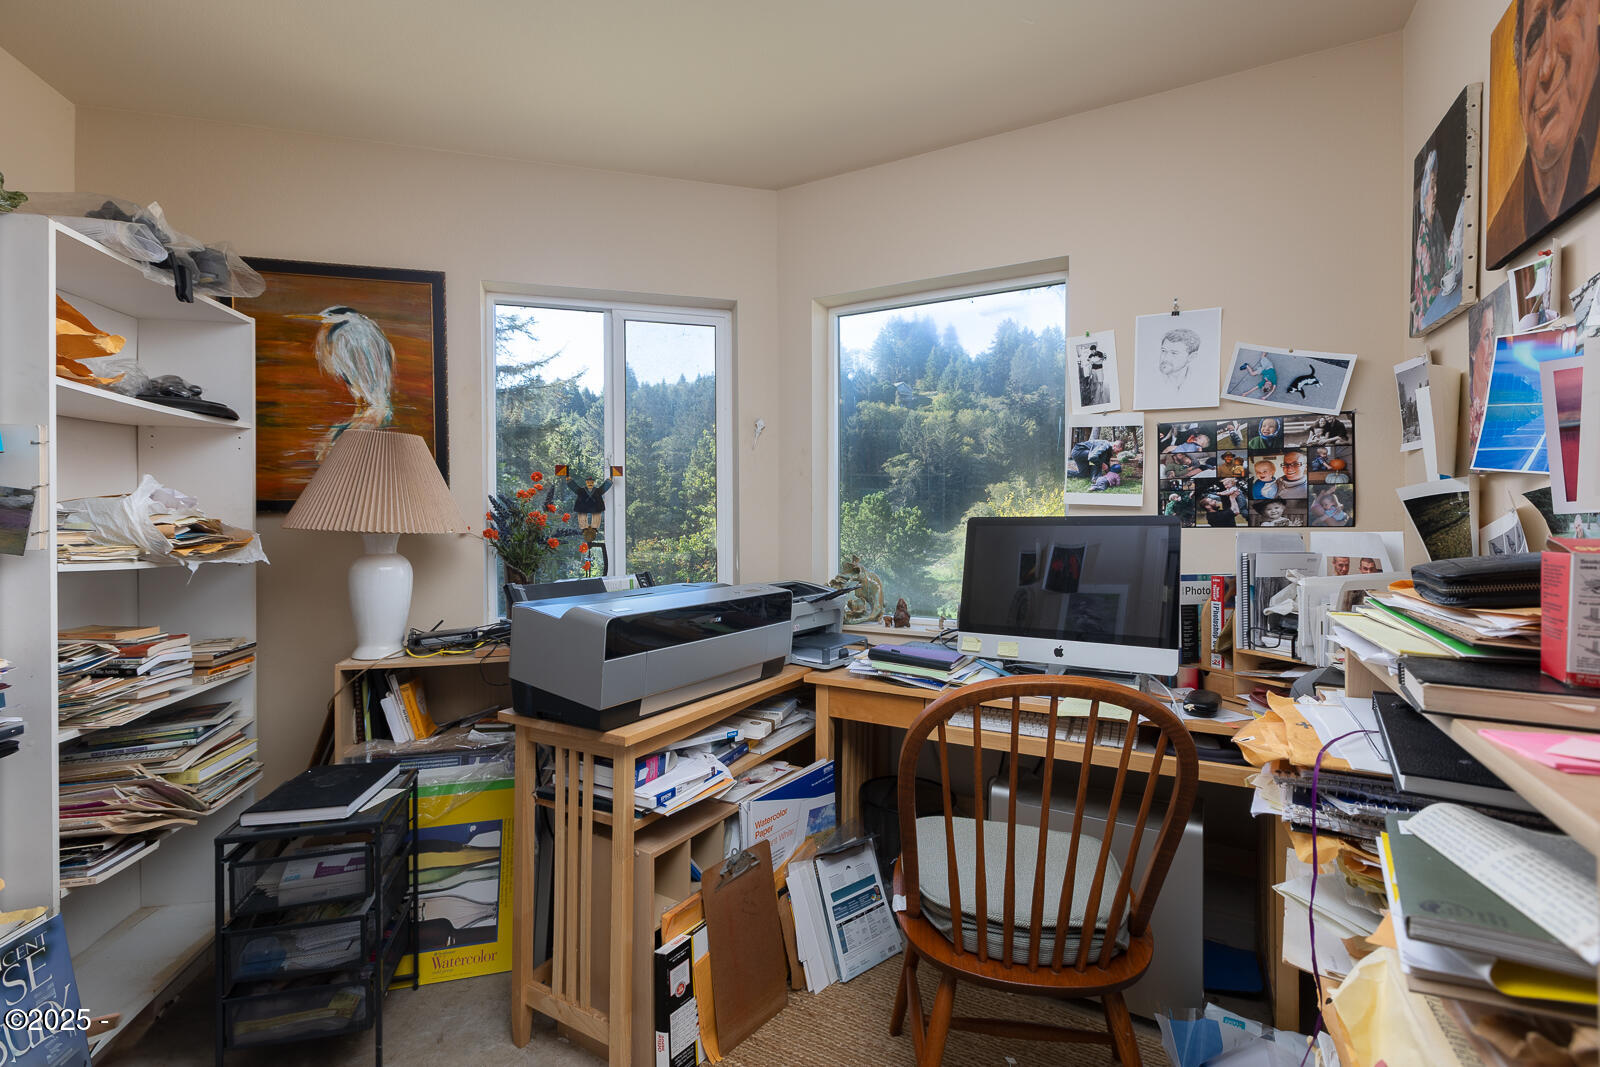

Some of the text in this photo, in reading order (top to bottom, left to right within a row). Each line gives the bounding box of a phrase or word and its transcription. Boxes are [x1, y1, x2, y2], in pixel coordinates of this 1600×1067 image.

[1185, 586, 1211, 596] Photo
[754, 808, 788, 829] Watercolor
[754, 825, 774, 840] Paper
[0, 933, 47, 970] CENT
[432, 948, 498, 970] Watercolor
